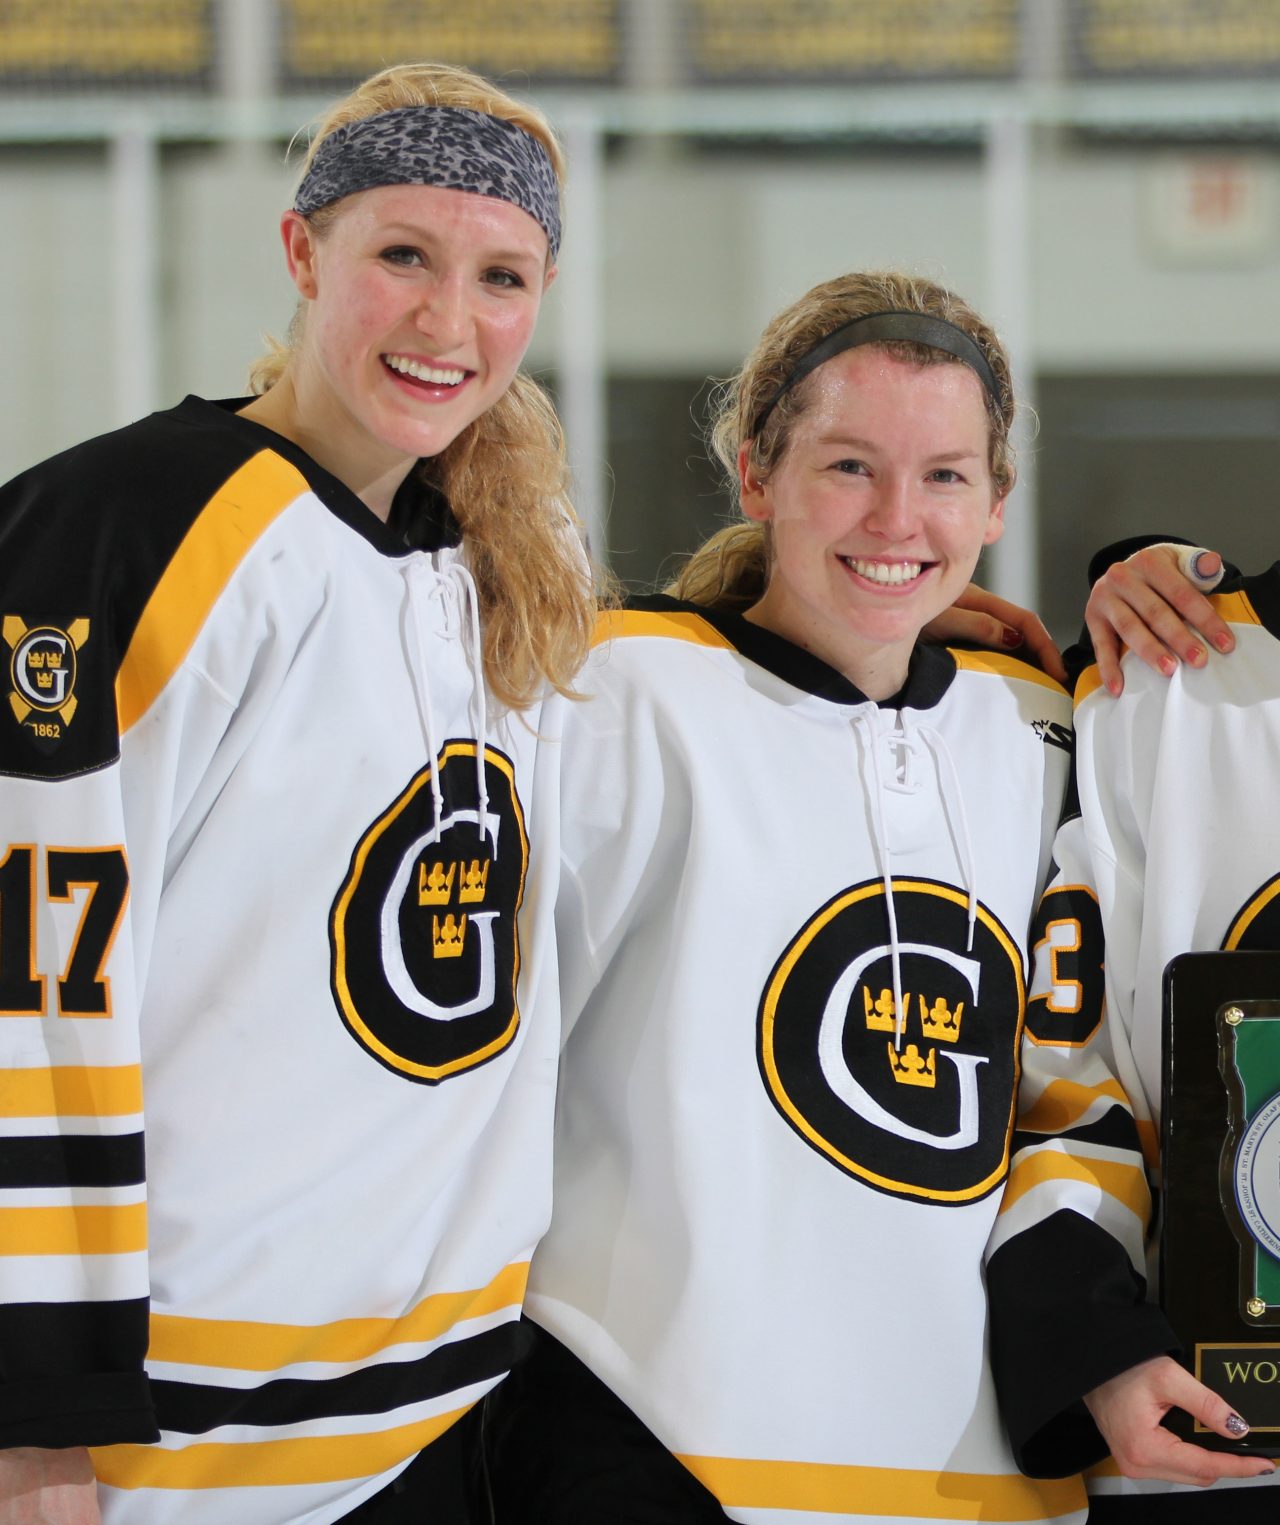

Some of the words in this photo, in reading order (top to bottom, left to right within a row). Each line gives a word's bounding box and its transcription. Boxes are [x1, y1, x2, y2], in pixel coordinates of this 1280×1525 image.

[17, 636, 69, 704] G
[32, 723, 60, 738] 1862
[0, 843, 130, 1019] 17
[381, 809, 500, 1021] G
[818, 942, 989, 1150] G
[1262, 1105, 1278, 1121] OLAF
